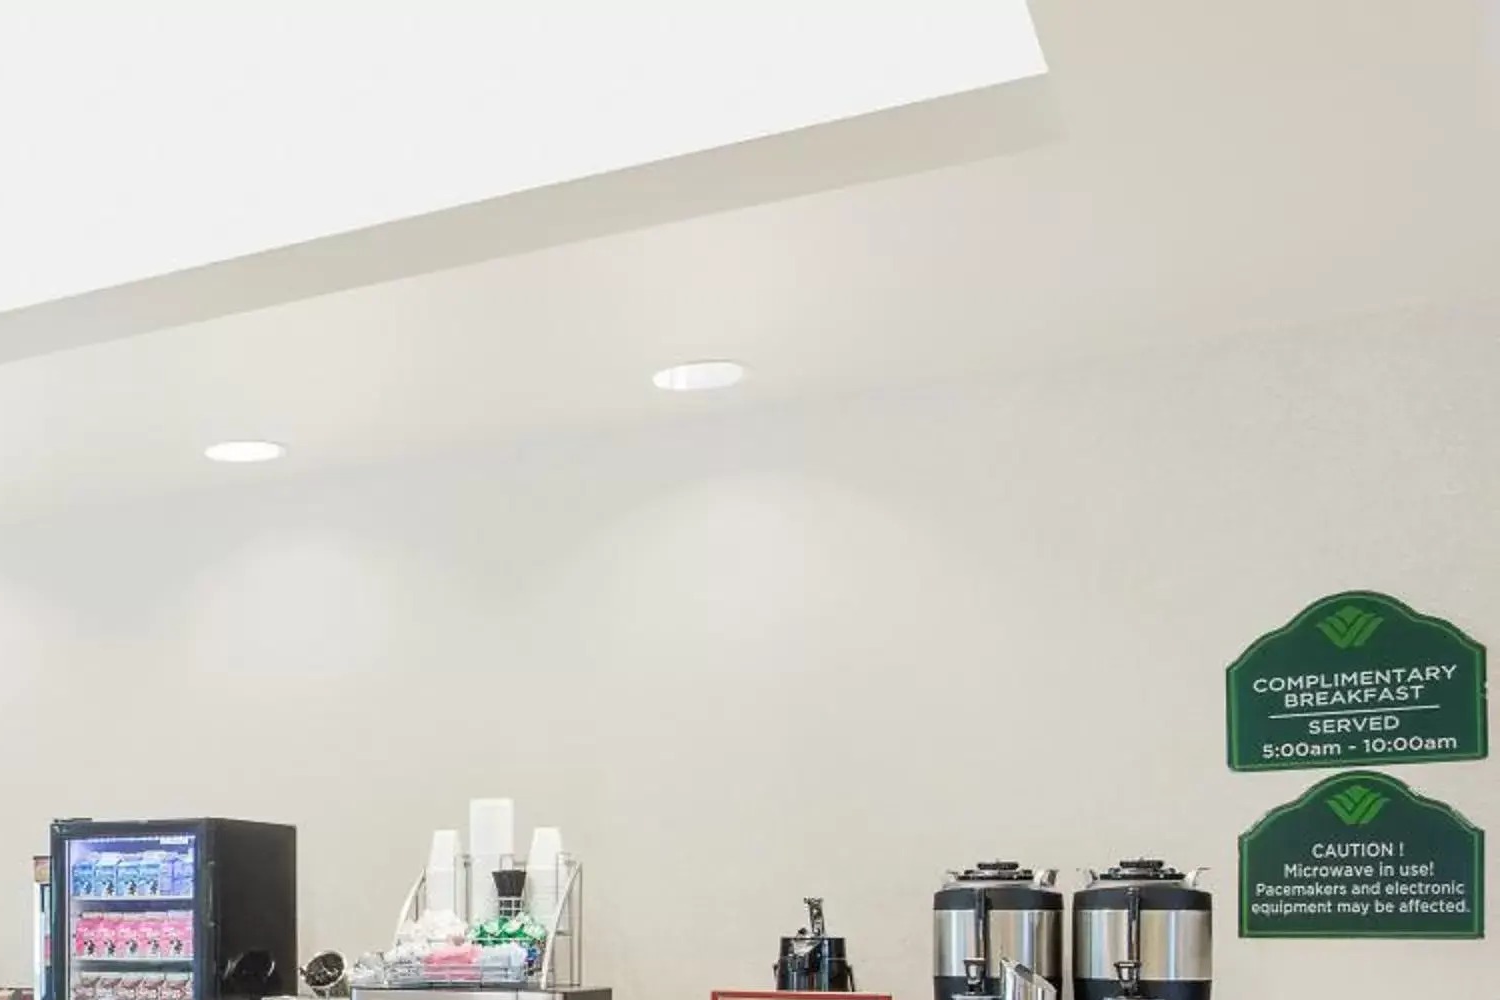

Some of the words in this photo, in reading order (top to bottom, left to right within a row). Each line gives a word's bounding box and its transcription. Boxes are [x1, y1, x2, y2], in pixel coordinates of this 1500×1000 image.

[1253, 664, 1457, 693] COMPLIMENTARY
[1284, 685, 1425, 708] BREAKFAST
[1308, 715, 1400, 735] SERVED
[1262, 742, 1341, 759] 5:00am
[1363, 736, 1457, 753] 10:00am
[1311, 842, 1393, 858] CAUTION
[1284, 863, 1374, 879] Microwave
[1379, 861, 1395, 877] in
[1399, 861, 1435, 877] use!
[1255, 882, 1347, 897] Pacemakers
[1351, 881, 1381, 895] and
[1385, 880, 1465, 895] electronic
[1251, 900, 1332, 917] equipment
[1337, 902, 1369, 917] may
[1375, 900, 1395, 913] be
[1399, 899, 1471, 913] affected.
